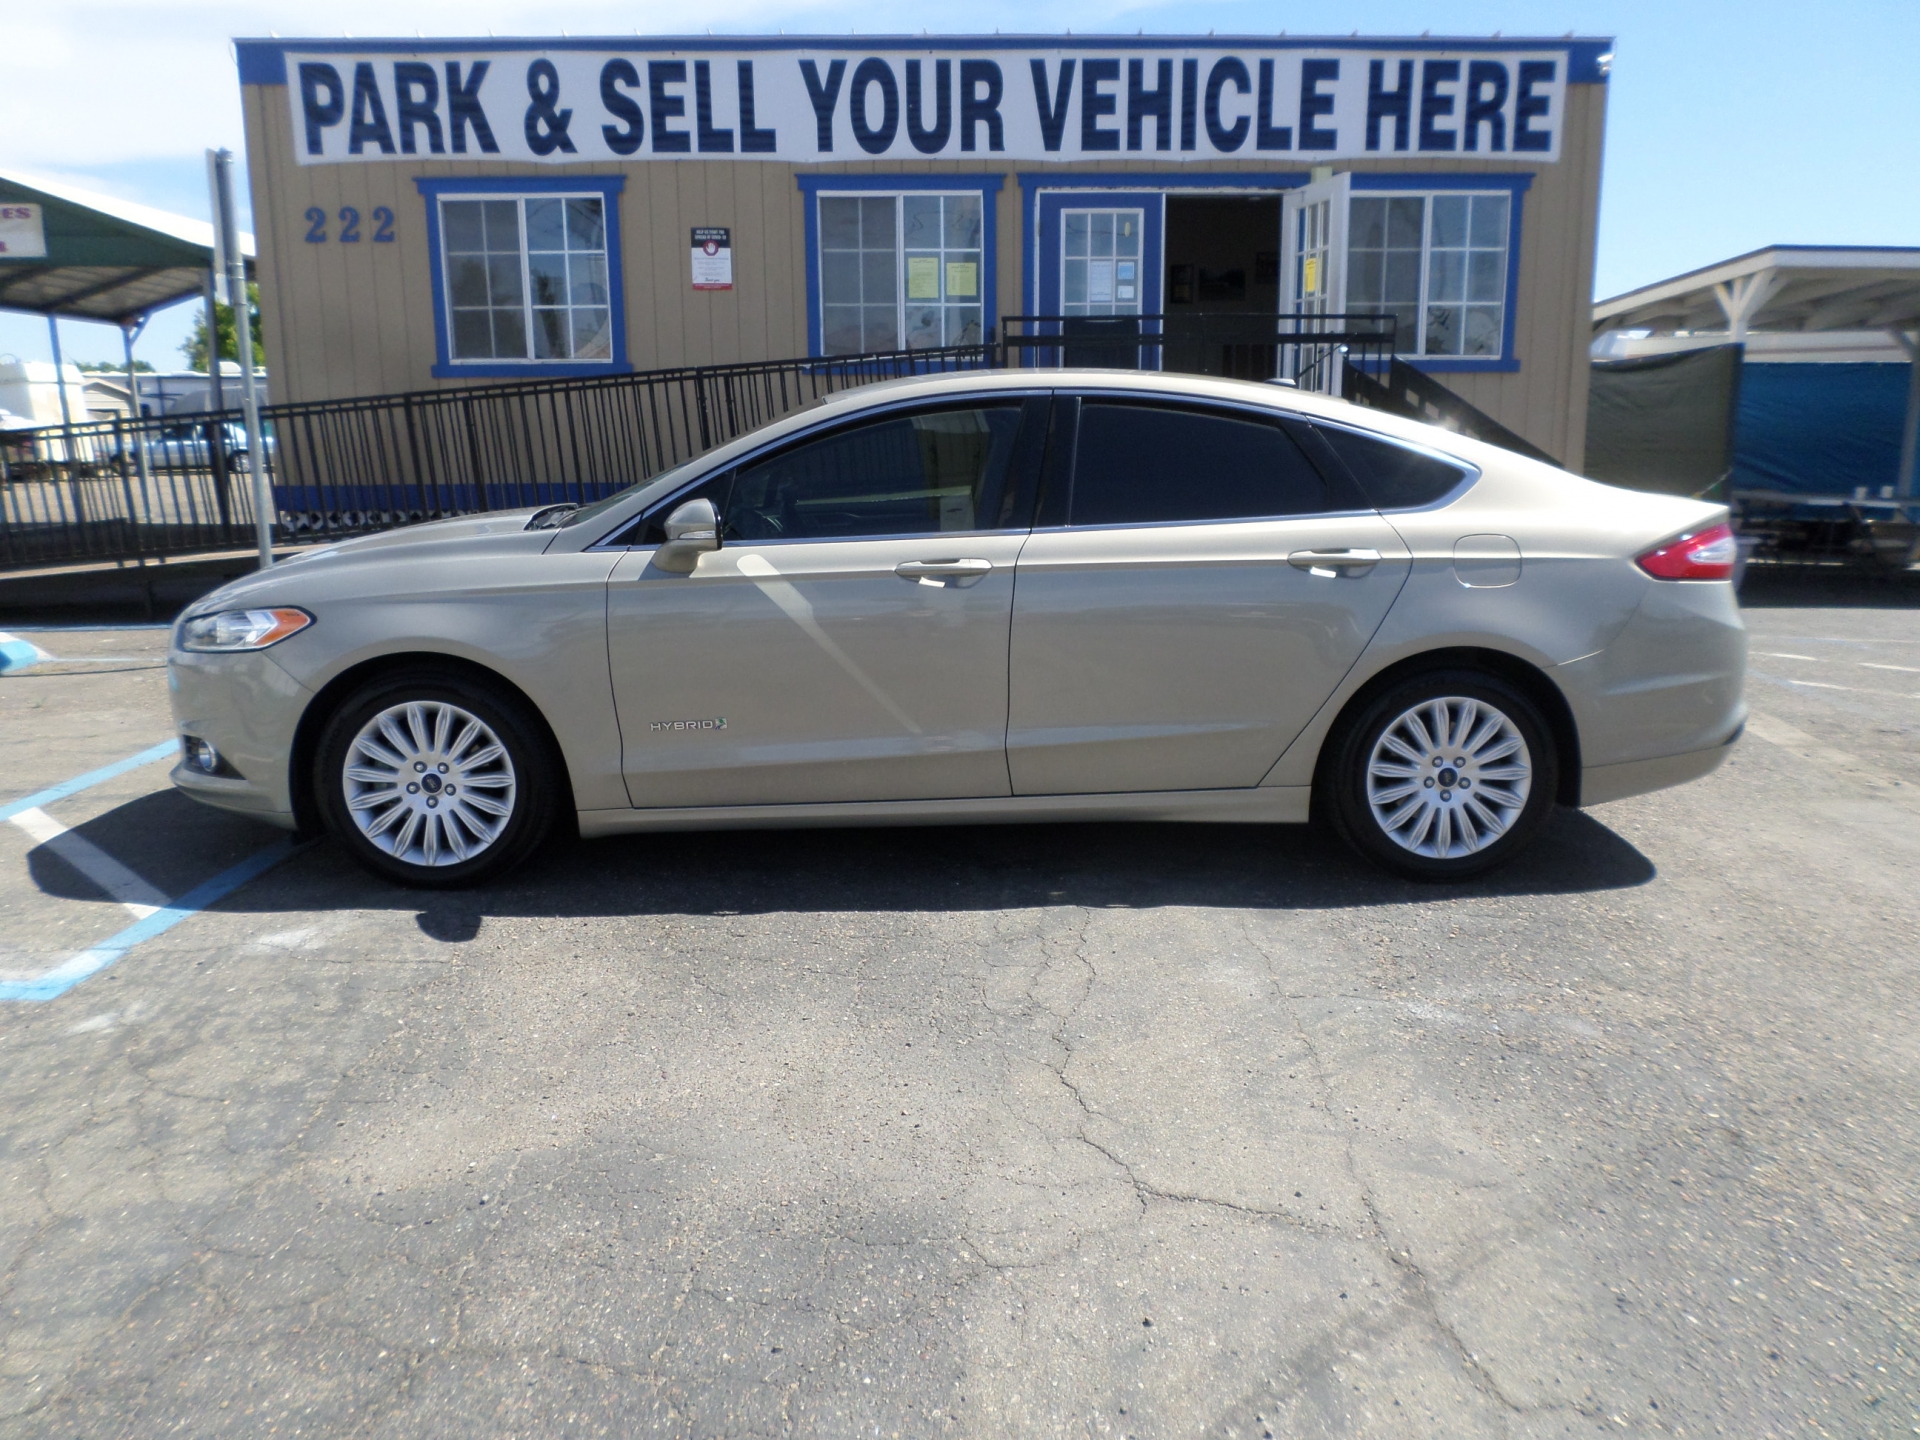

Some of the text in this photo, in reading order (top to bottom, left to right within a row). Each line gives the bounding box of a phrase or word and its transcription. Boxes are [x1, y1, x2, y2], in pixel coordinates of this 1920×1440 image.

[299, 55, 1557, 157] PARK & SELL YOUR VEHICLE HERE
[304, 206, 396, 243] 222
[650, 720, 713, 732] HYBRID
